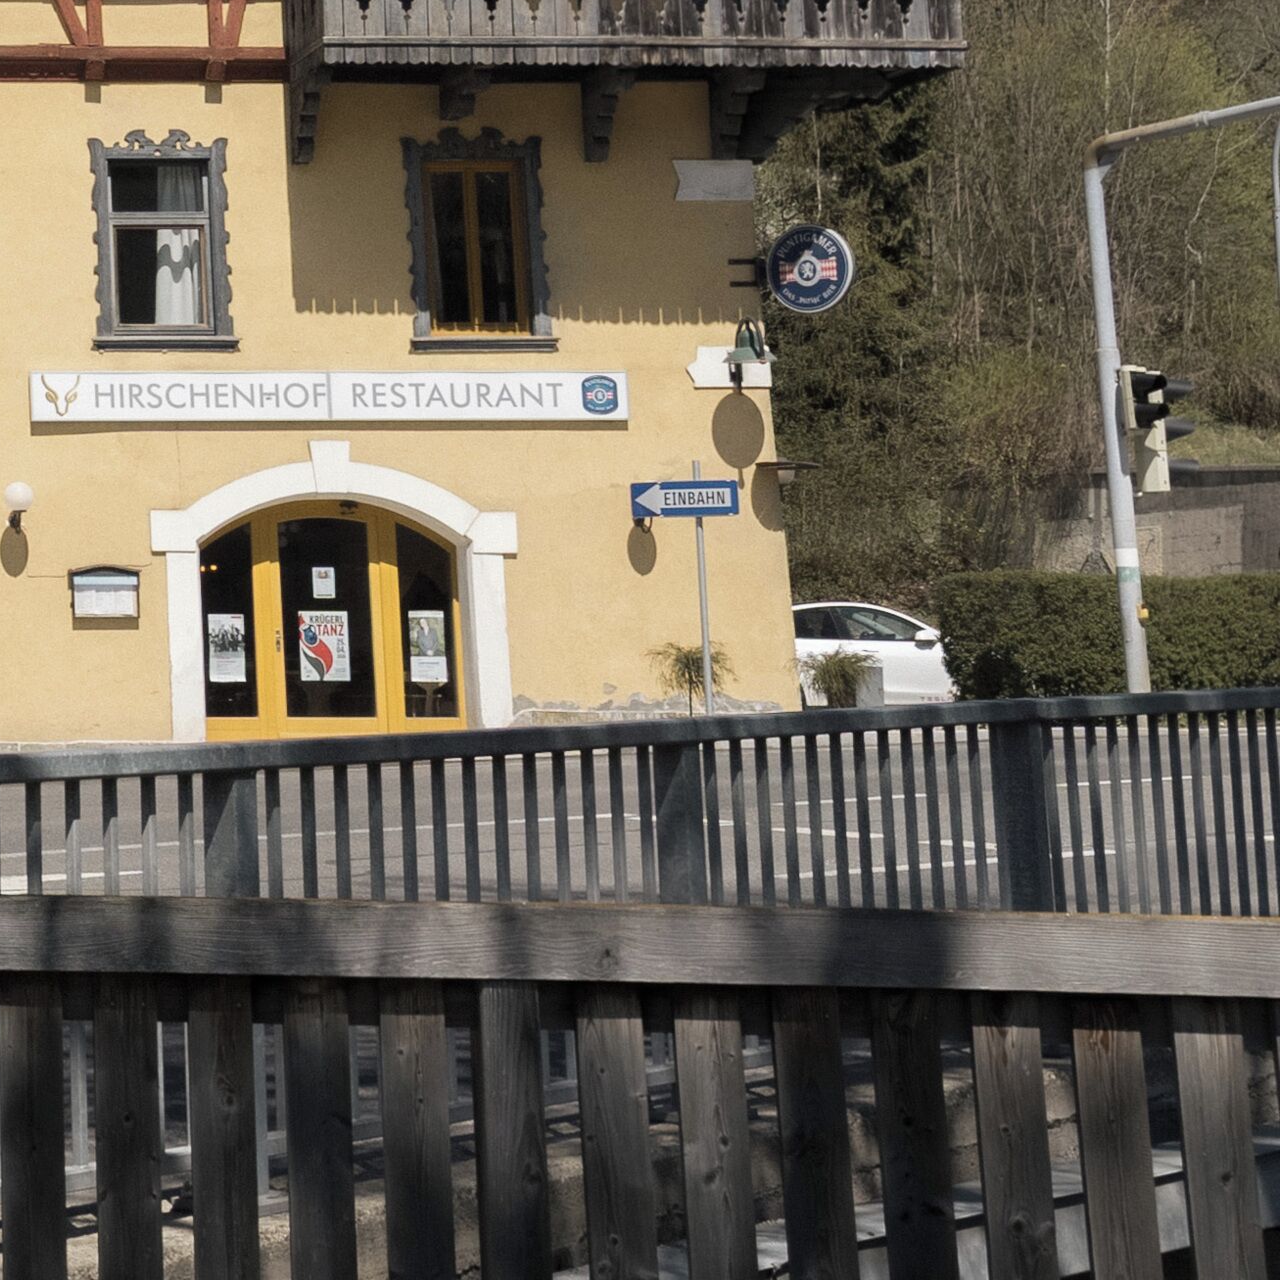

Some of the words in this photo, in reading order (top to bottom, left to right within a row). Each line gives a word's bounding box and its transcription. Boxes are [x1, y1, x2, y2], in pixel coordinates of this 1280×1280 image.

[776, 232, 838, 258] PUNTIGAMER
[94, 382, 326, 409] HIRSCHENHOF
[351, 382, 563, 408] RESTAURANT
[664, 490, 726, 506] EINBAHN
[309, 613, 344, 624] KRÜGERL
[316, 624, 344, 637] TANZ
